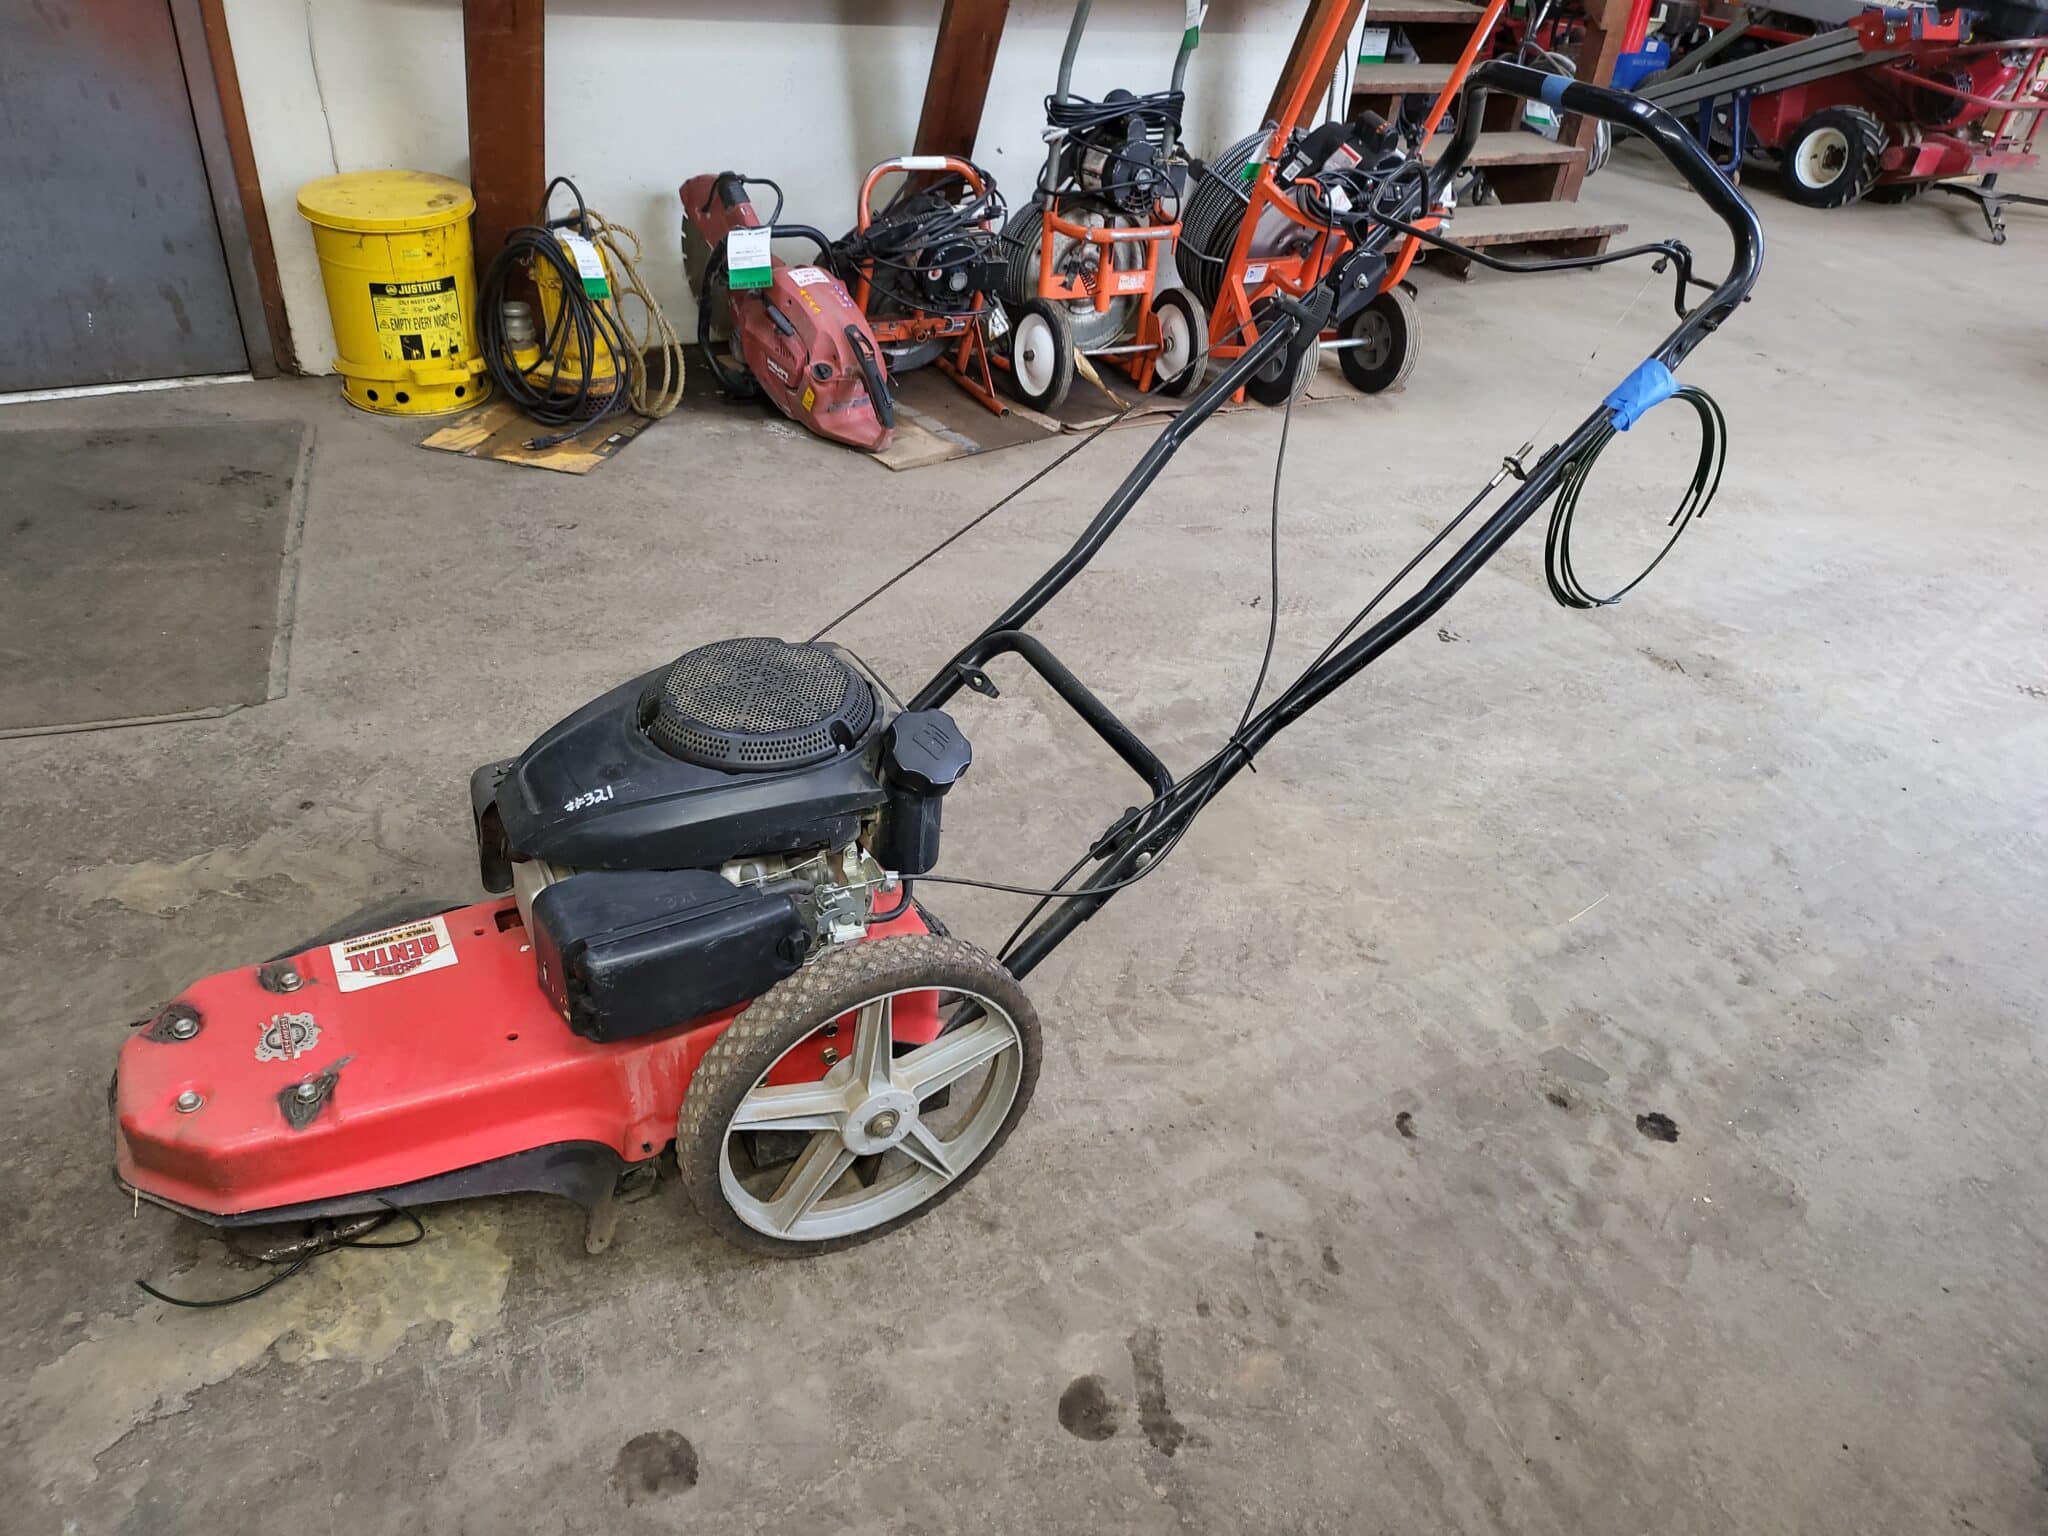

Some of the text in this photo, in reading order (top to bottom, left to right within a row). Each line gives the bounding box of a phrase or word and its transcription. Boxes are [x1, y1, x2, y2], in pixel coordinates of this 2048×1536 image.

[398, 281, 442, 295] JUSTRITE
[390, 313, 450, 331] EMPTY EVERY NIGHT
[406, 926, 434, 937] TOOLS
[345, 935, 395, 954] EQUIPMENT
[345, 934, 440, 972] RENTAL
